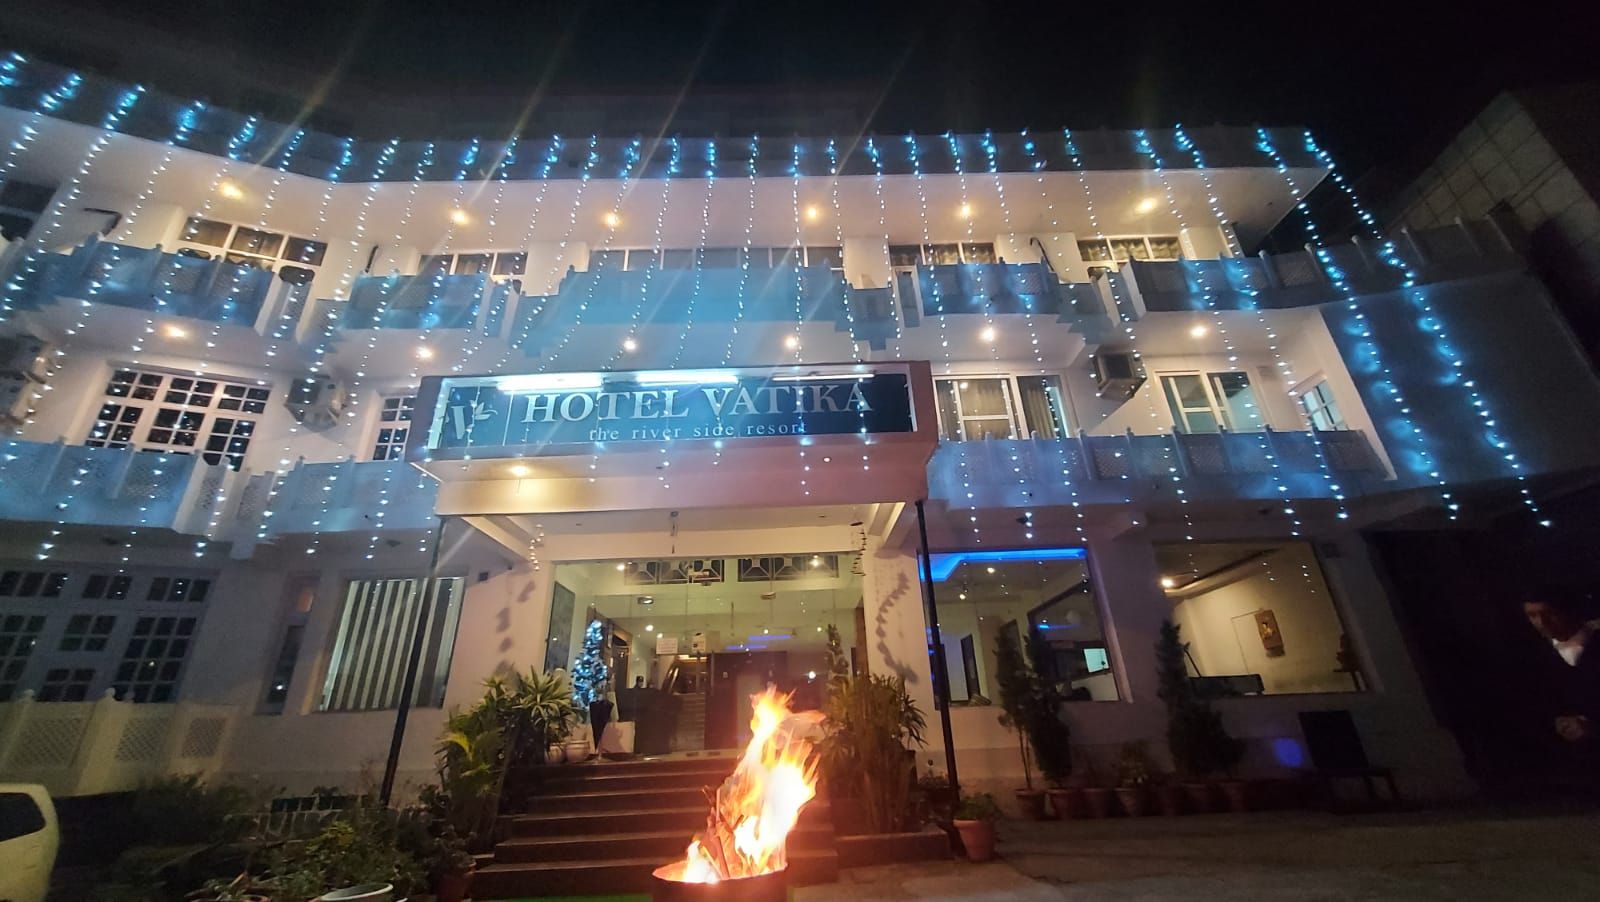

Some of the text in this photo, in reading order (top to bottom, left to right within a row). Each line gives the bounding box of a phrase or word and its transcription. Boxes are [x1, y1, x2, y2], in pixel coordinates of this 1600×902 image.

[521, 383, 873, 423] HOTEL VATIKA
[589, 420, 807, 441] the river side resort
